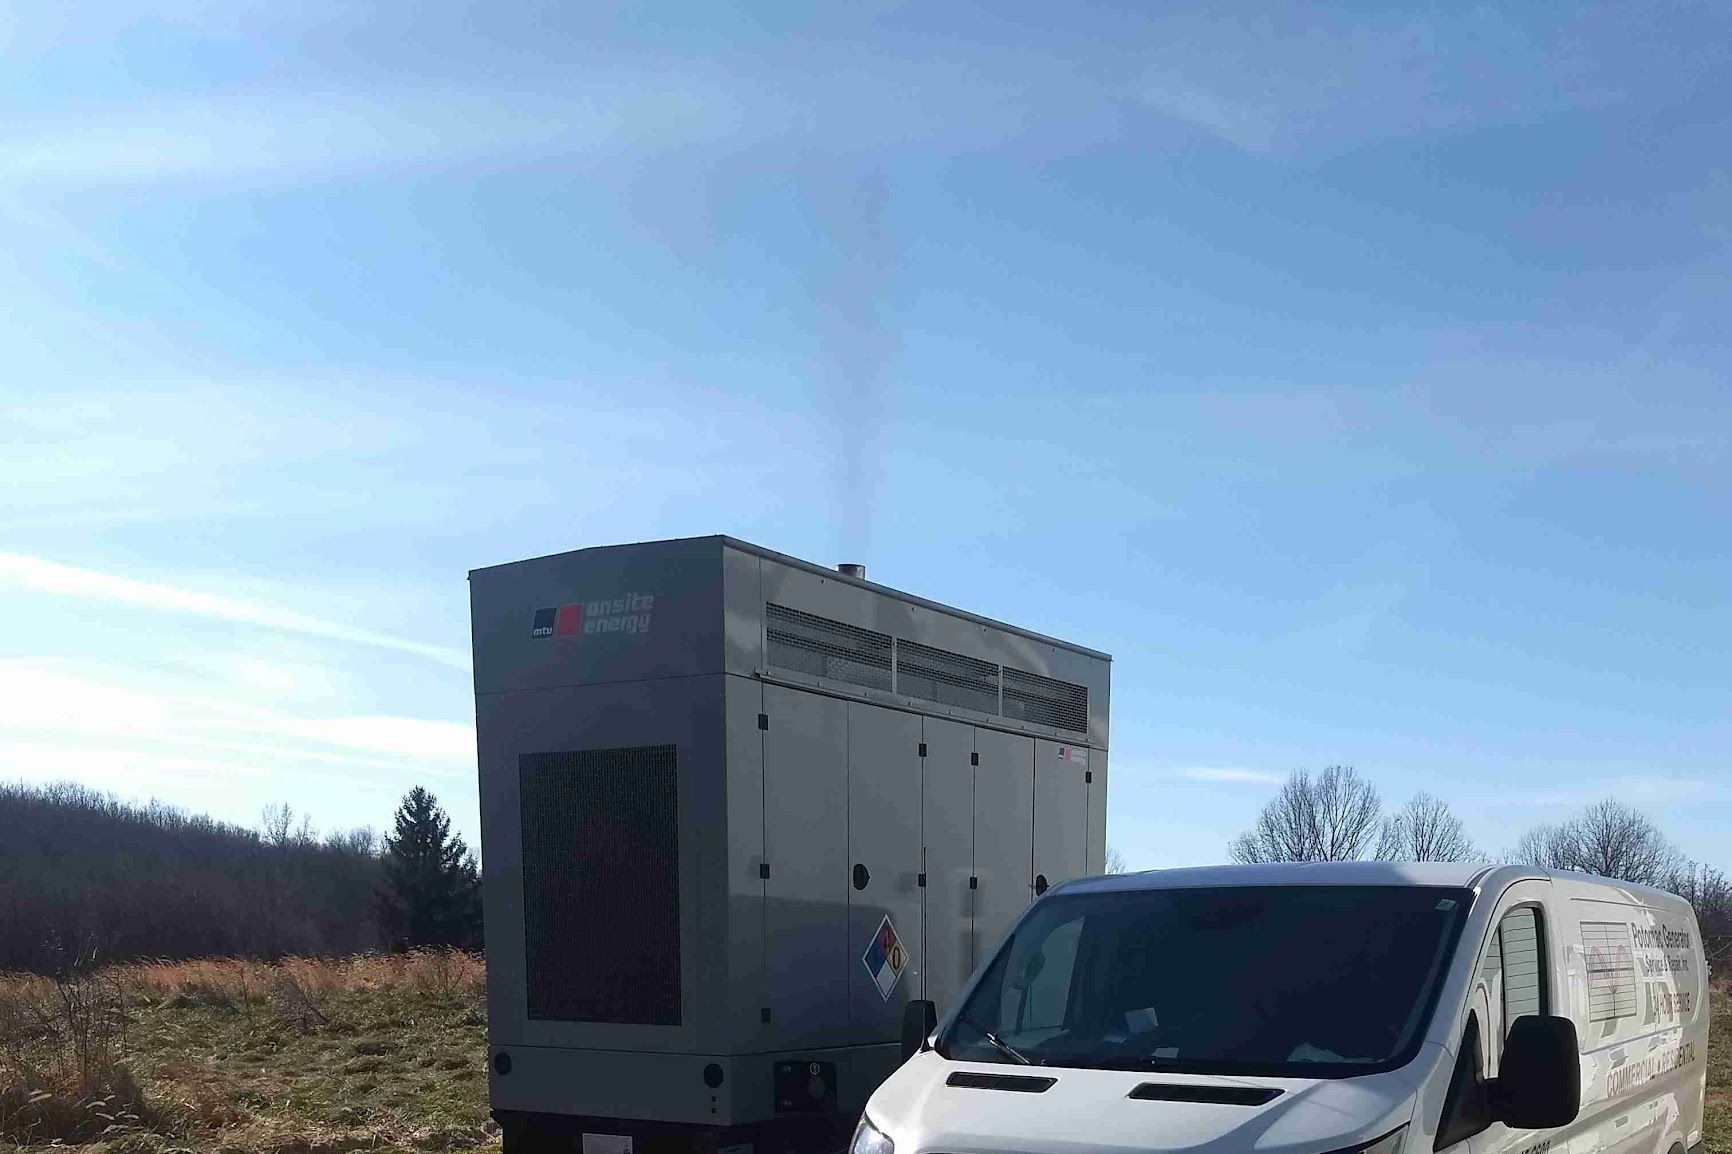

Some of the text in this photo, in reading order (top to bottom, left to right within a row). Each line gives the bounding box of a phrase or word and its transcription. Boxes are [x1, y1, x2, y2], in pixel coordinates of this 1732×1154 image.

[585, 592, 654, 616] onsite
[533, 626, 553, 637] mtu
[584, 613, 651, 634] energy
[1630, 922, 1662, 949] Potomac
[892, 946, 900, 970] 0
[1606, 1040, 1695, 1098] COMMERCIAL RESIDENTIAL
